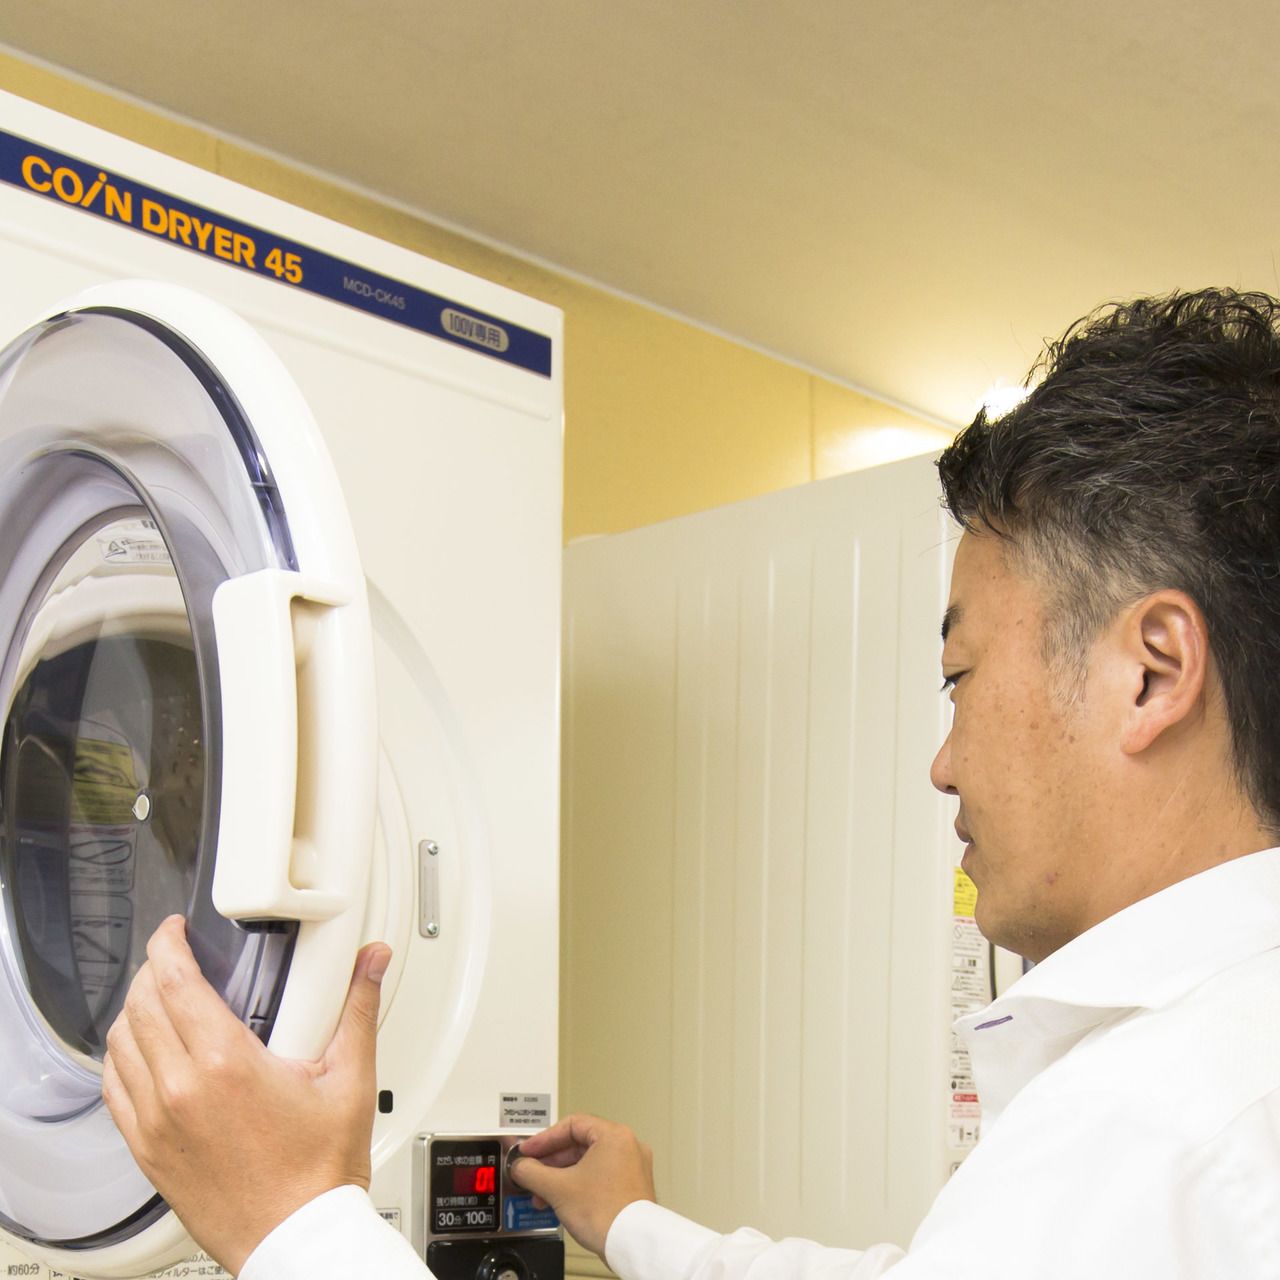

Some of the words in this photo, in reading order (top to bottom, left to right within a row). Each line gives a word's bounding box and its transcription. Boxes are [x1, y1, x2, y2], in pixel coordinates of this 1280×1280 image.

[142, 198, 256, 269] DRYER
[264, 248, 303, 284] 45
[343, 276, 406, 311] MCD-CK45
[449, 312, 501, 348] 100V専用
[7, 1263, 40, 1276] 約60分
